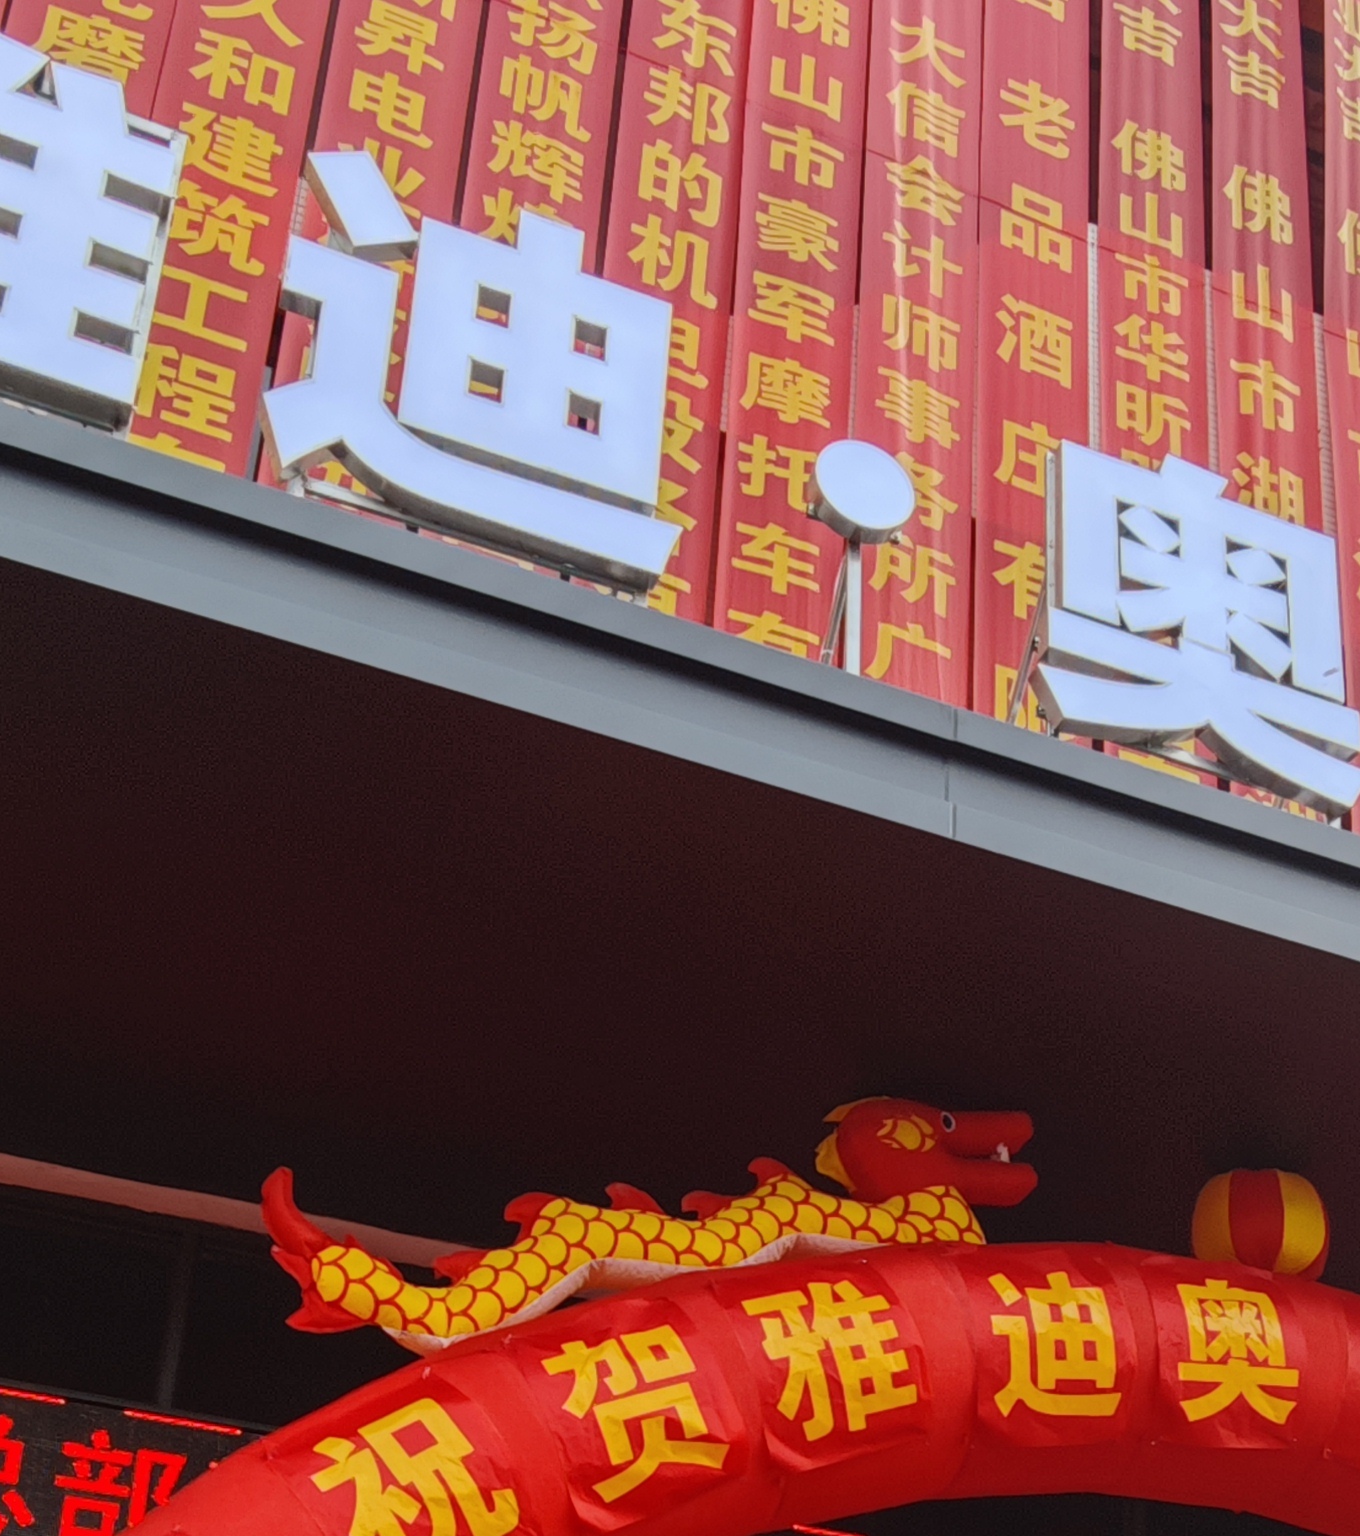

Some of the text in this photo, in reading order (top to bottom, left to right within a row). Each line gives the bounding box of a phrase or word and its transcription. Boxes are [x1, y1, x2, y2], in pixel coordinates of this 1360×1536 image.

[1110, 118, 1190, 472] 佛山市华昕
